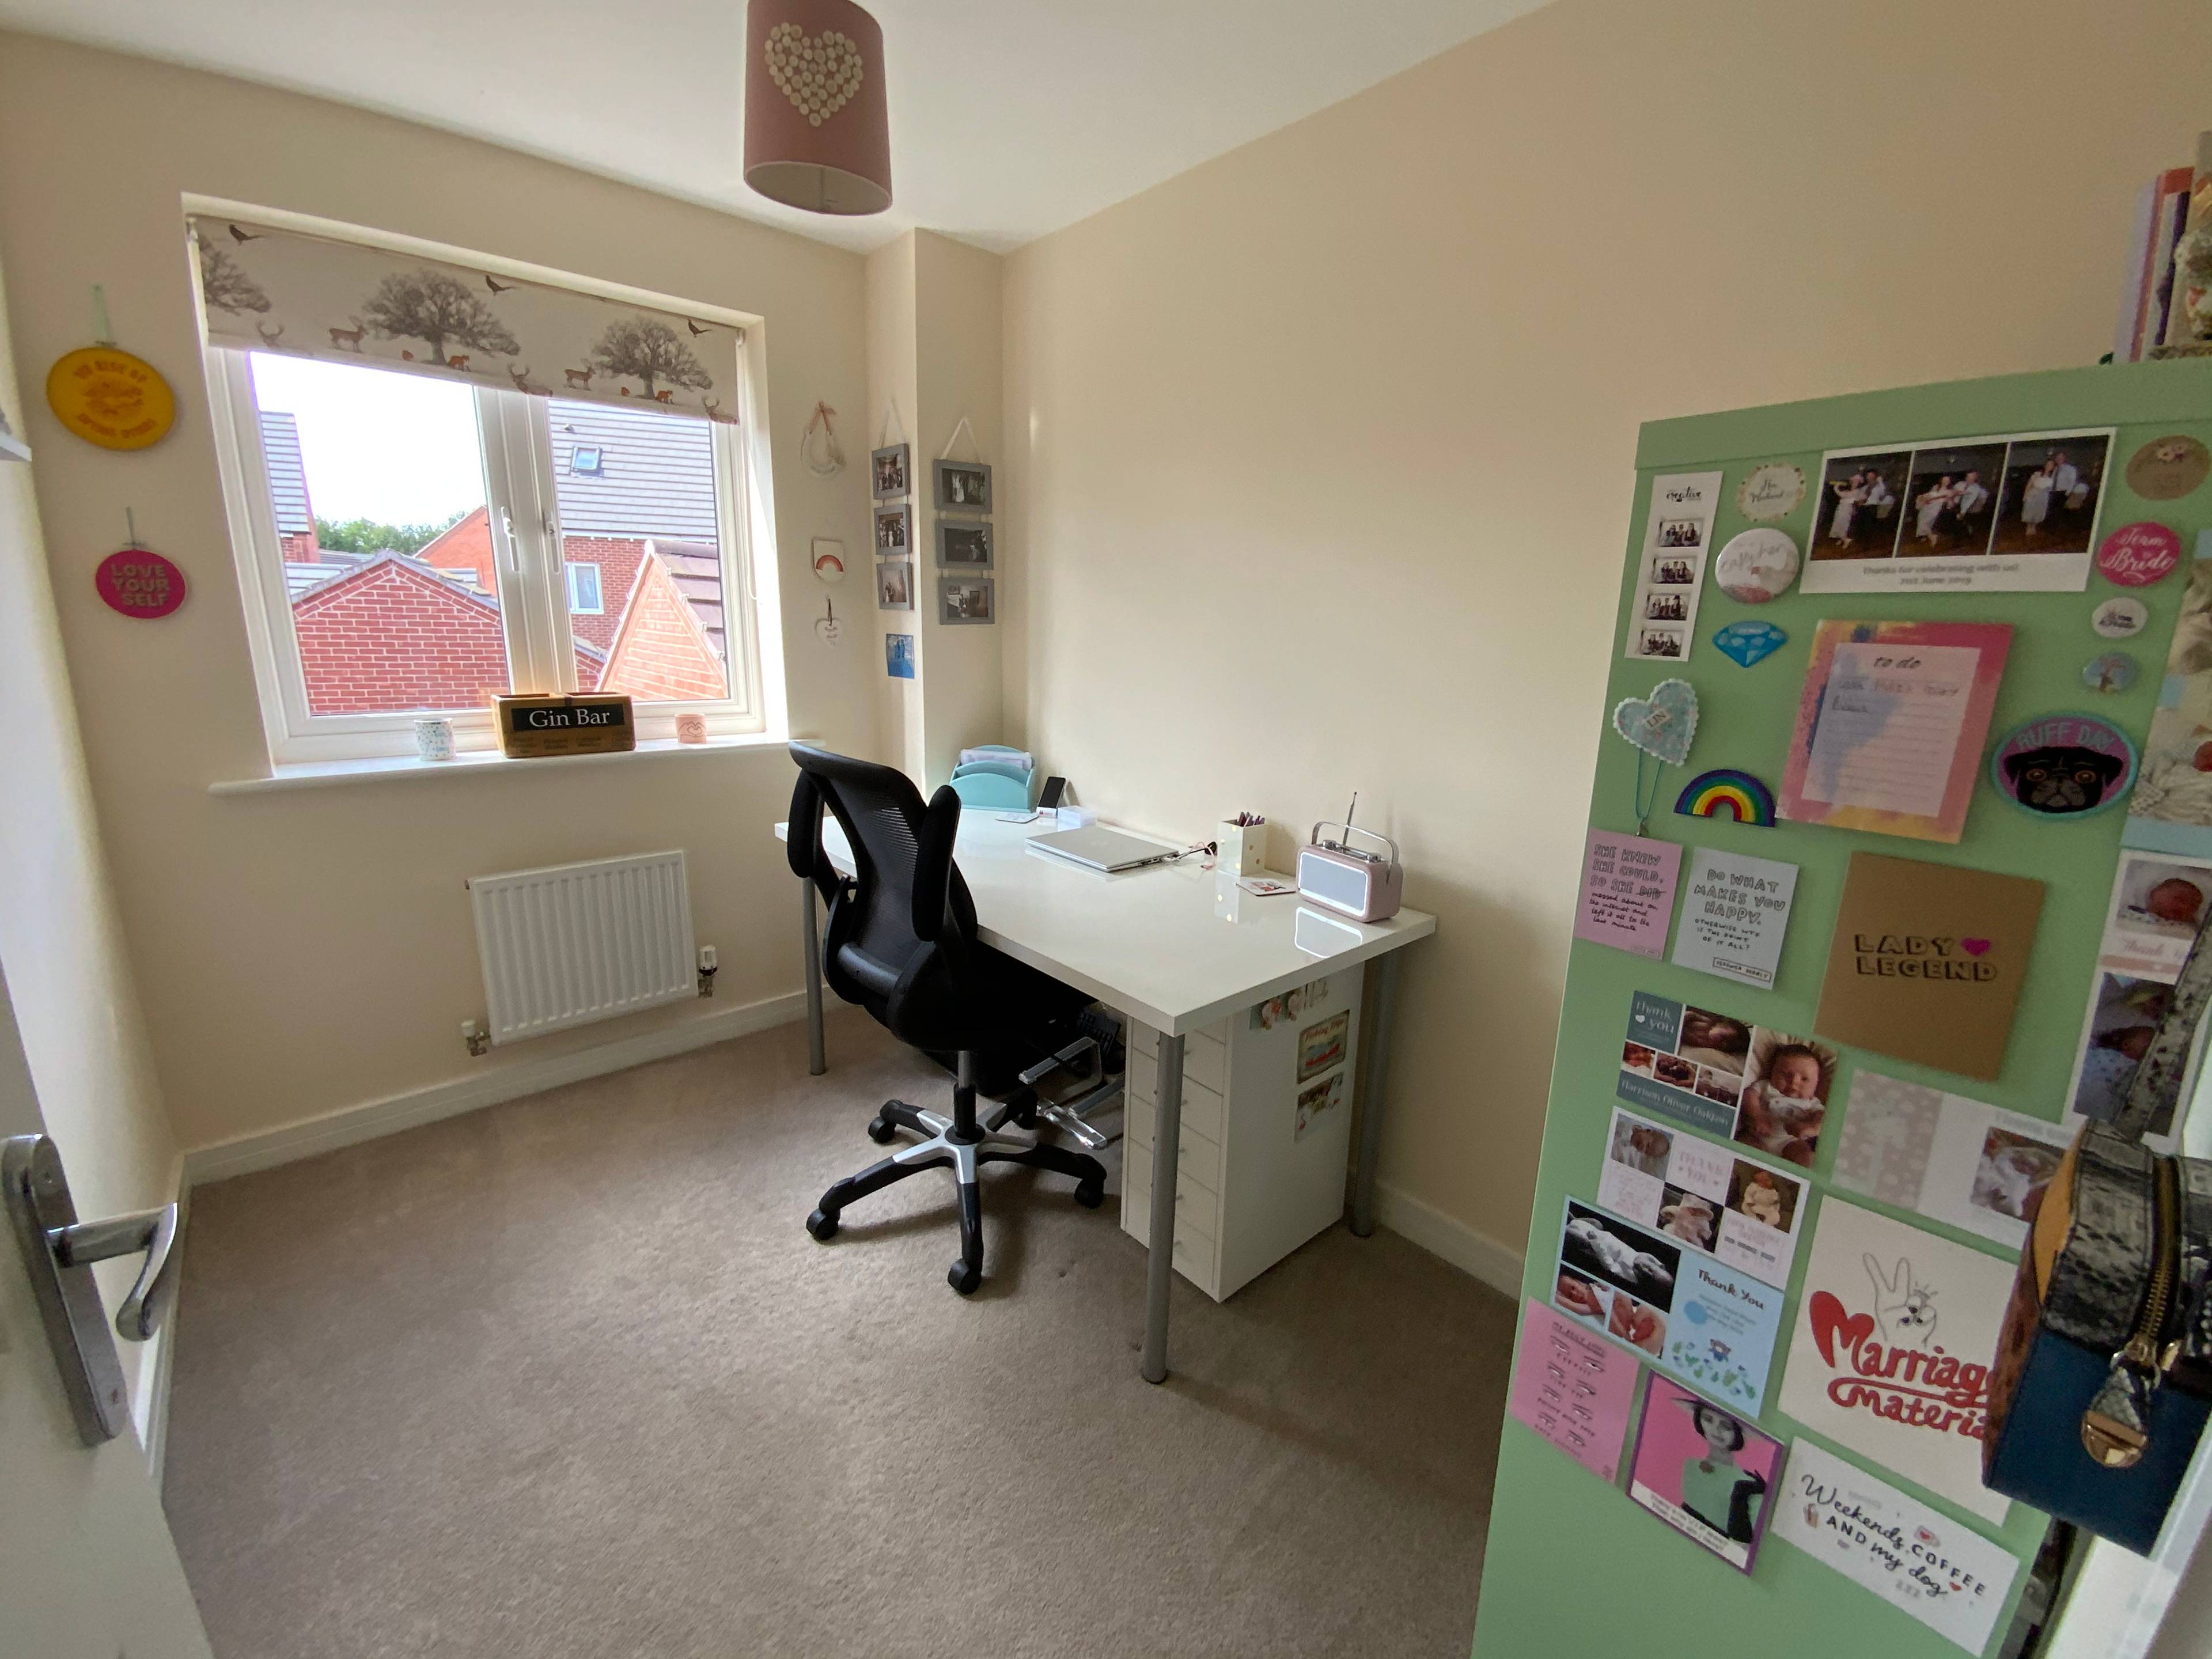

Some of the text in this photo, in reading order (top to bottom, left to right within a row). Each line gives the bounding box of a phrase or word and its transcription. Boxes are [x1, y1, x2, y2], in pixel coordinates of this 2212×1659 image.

[111, 564, 166, 577] LOVE
[111, 577, 169, 592] YOUR
[122, 593, 169, 607] SELF
[1873, 656, 1922, 669] to do
[529, 709, 611, 728] Gin Bar
[1594, 844, 1661, 866] SHE KNEW
[1592, 858, 1615, 873] SHE
[1589, 875, 1607, 887] SO
[1611, 878, 1634, 893] SHE
[1707, 869, 1779, 893] DO WHAT
[1621, 897, 1643, 907] about
[1694, 884, 1786, 911] MAKES YOU
[1591, 907, 1605, 917] left
[1639, 918, 1650, 927] the
[1695, 918, 1737, 933] OTHERWISE
[1724, 933, 1749, 943] POINT
[1854, 934, 1955, 956] LADY
[1856, 956, 1998, 982] LEGEND
[1698, 1268, 1764, 1310] Thank You
[1801, 1474, 1904, 1550] Weekends
[1911, 1544, 1987, 1597] COFFEE
[1825, 1515, 1949, 1598] AND my dog
